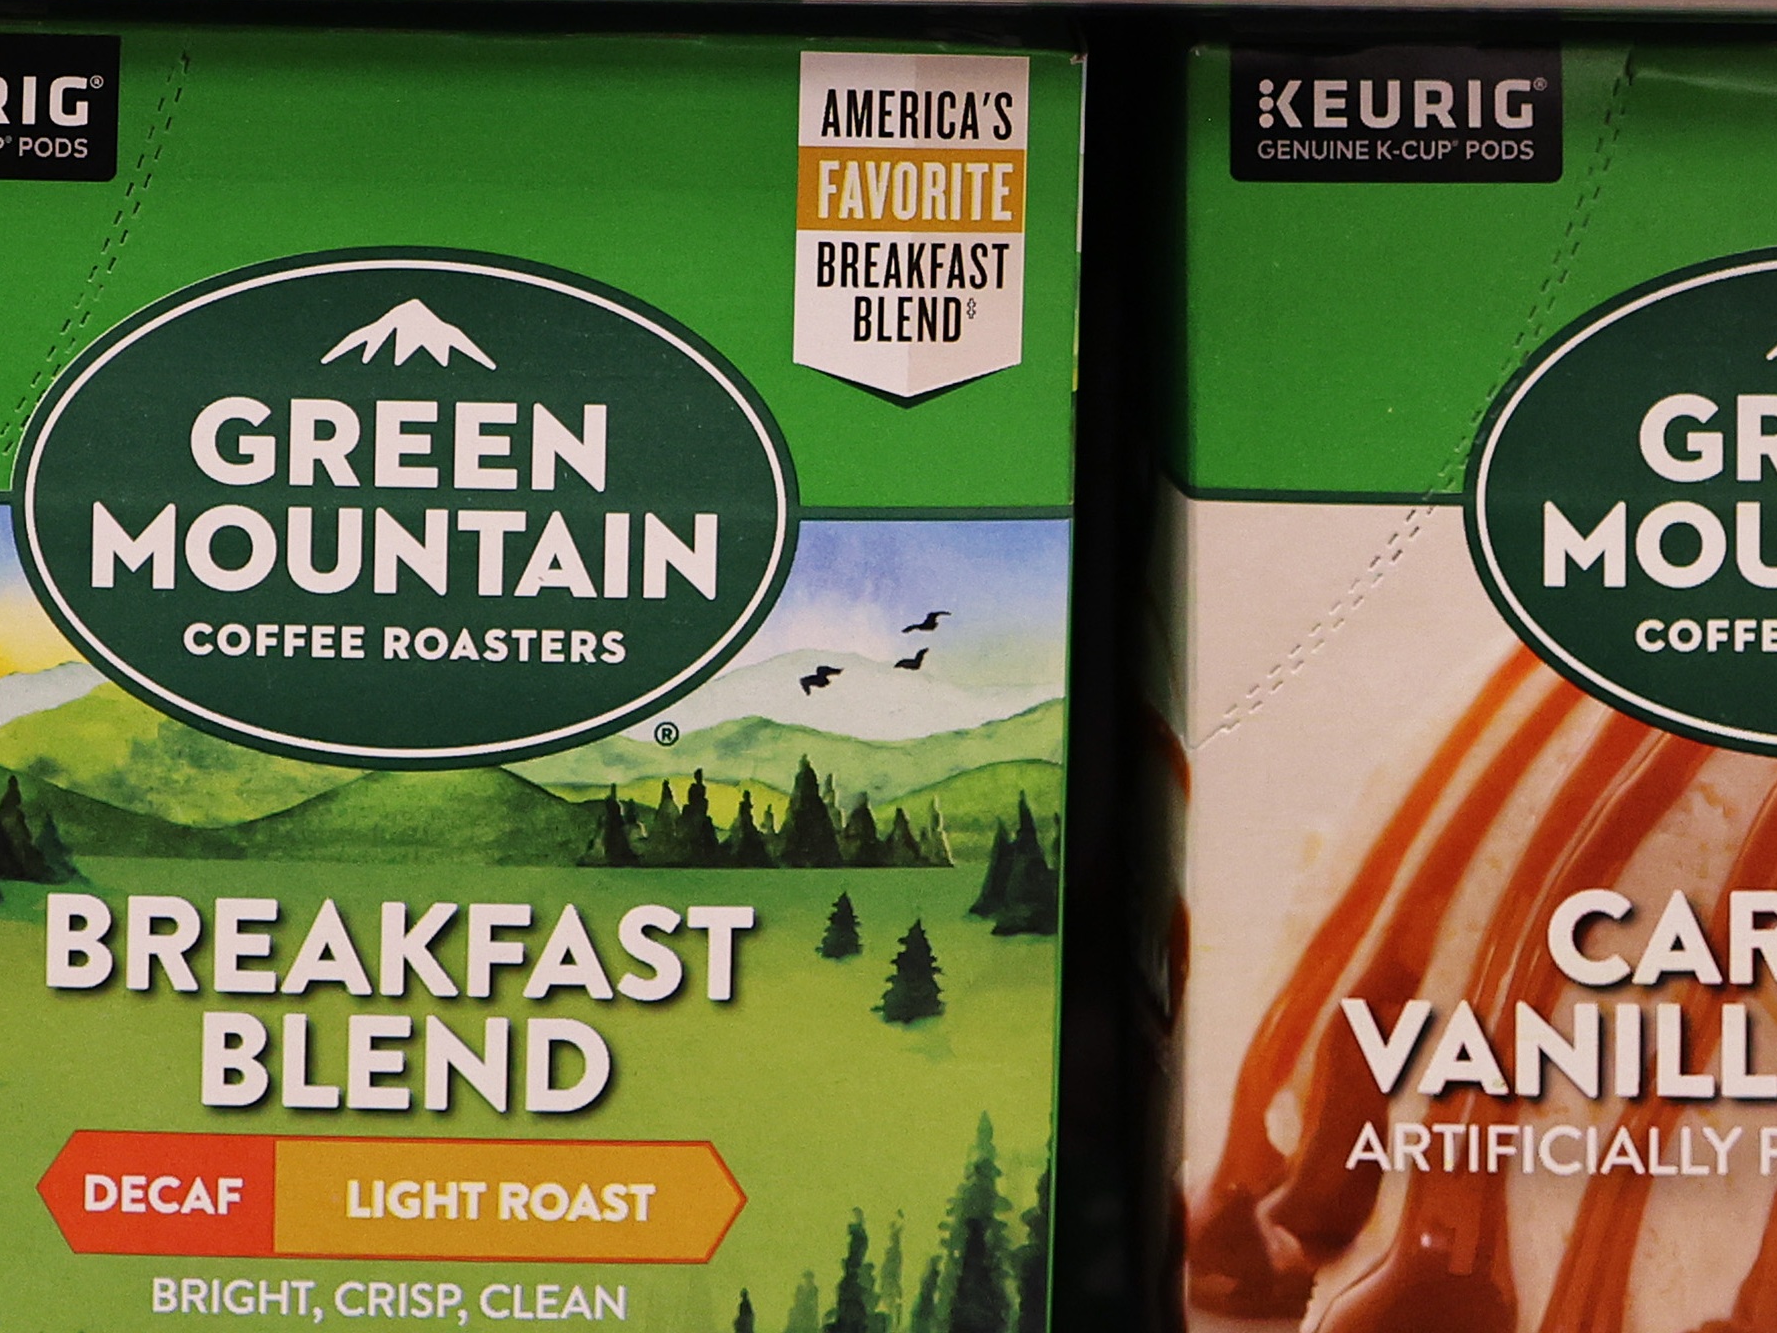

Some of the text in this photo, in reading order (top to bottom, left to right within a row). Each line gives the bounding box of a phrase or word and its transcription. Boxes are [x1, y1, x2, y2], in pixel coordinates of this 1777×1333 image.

[821, 89, 1013, 141] AMERICA'S
[817, 160, 1014, 221] FAVORITE
[817, 242, 1009, 289] BREAKFAST
[191, 396, 608, 493] GREEN
[92, 501, 718, 600] MOUNTAIN
[183, 622, 626, 665] COFFEE ROASTERS
[45, 892, 755, 1002] BREAKFAST
[201, 1011, 611, 1113] BLEND
[1345, 1120, 1742, 1178] ARTIFICIALLY
[83, 1174, 656, 1223] DECAF LIGHT ROAST
[151, 1277, 626, 1327] BRIGHT, CRISP, CLEAN
